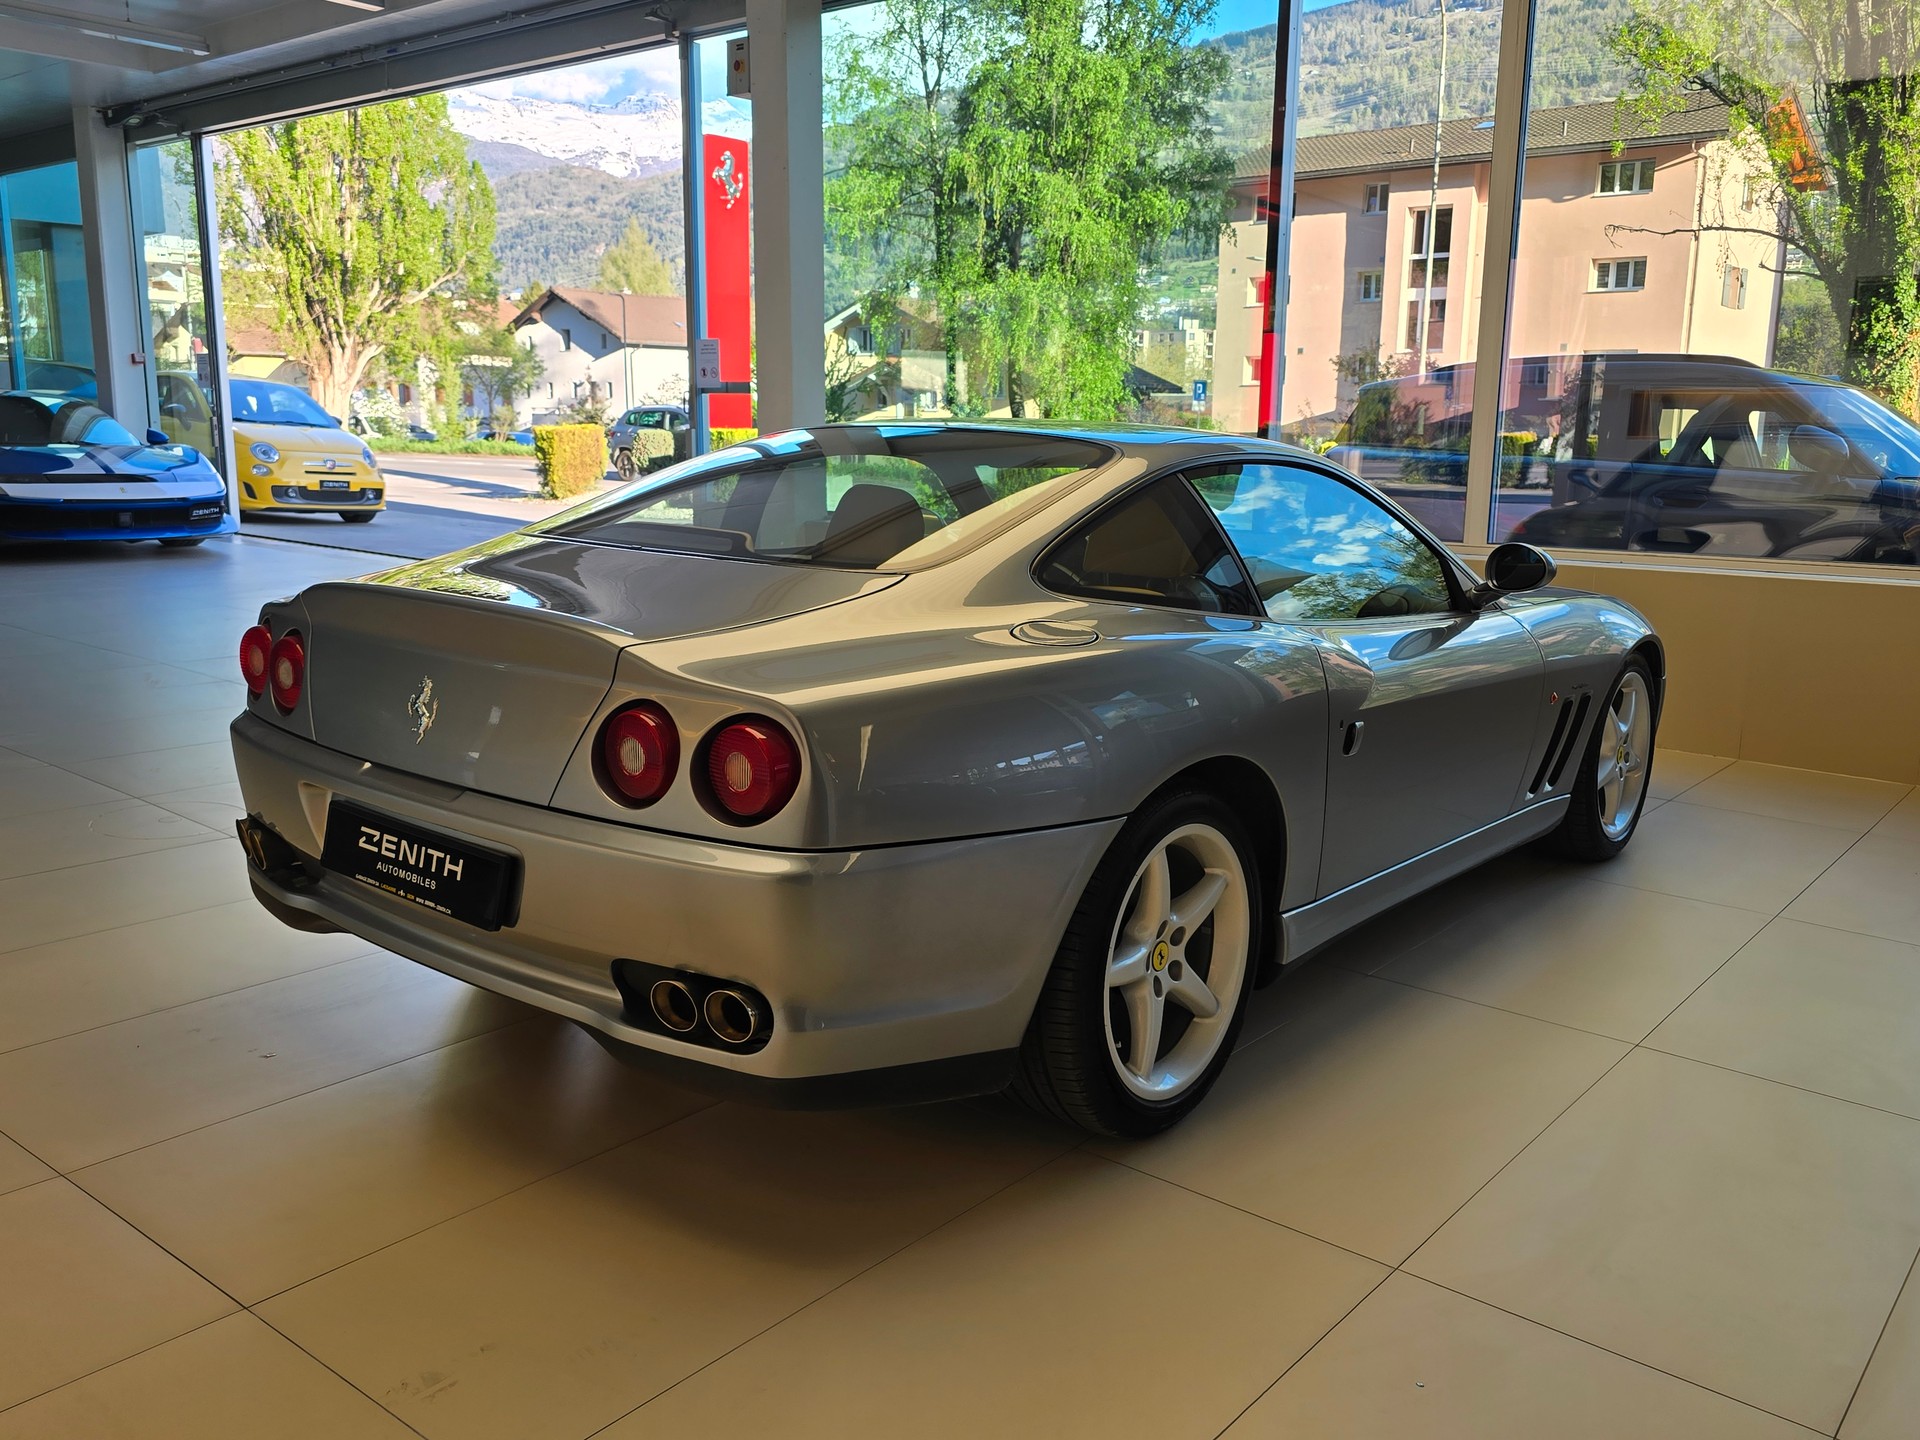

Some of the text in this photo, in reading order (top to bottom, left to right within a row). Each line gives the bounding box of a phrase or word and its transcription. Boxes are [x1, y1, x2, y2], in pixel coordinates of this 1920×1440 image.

[192, 507, 220, 516] ZENITH
[358, 826, 464, 881] ZENITH
[376, 861, 437, 890] AUTOMOBILES
